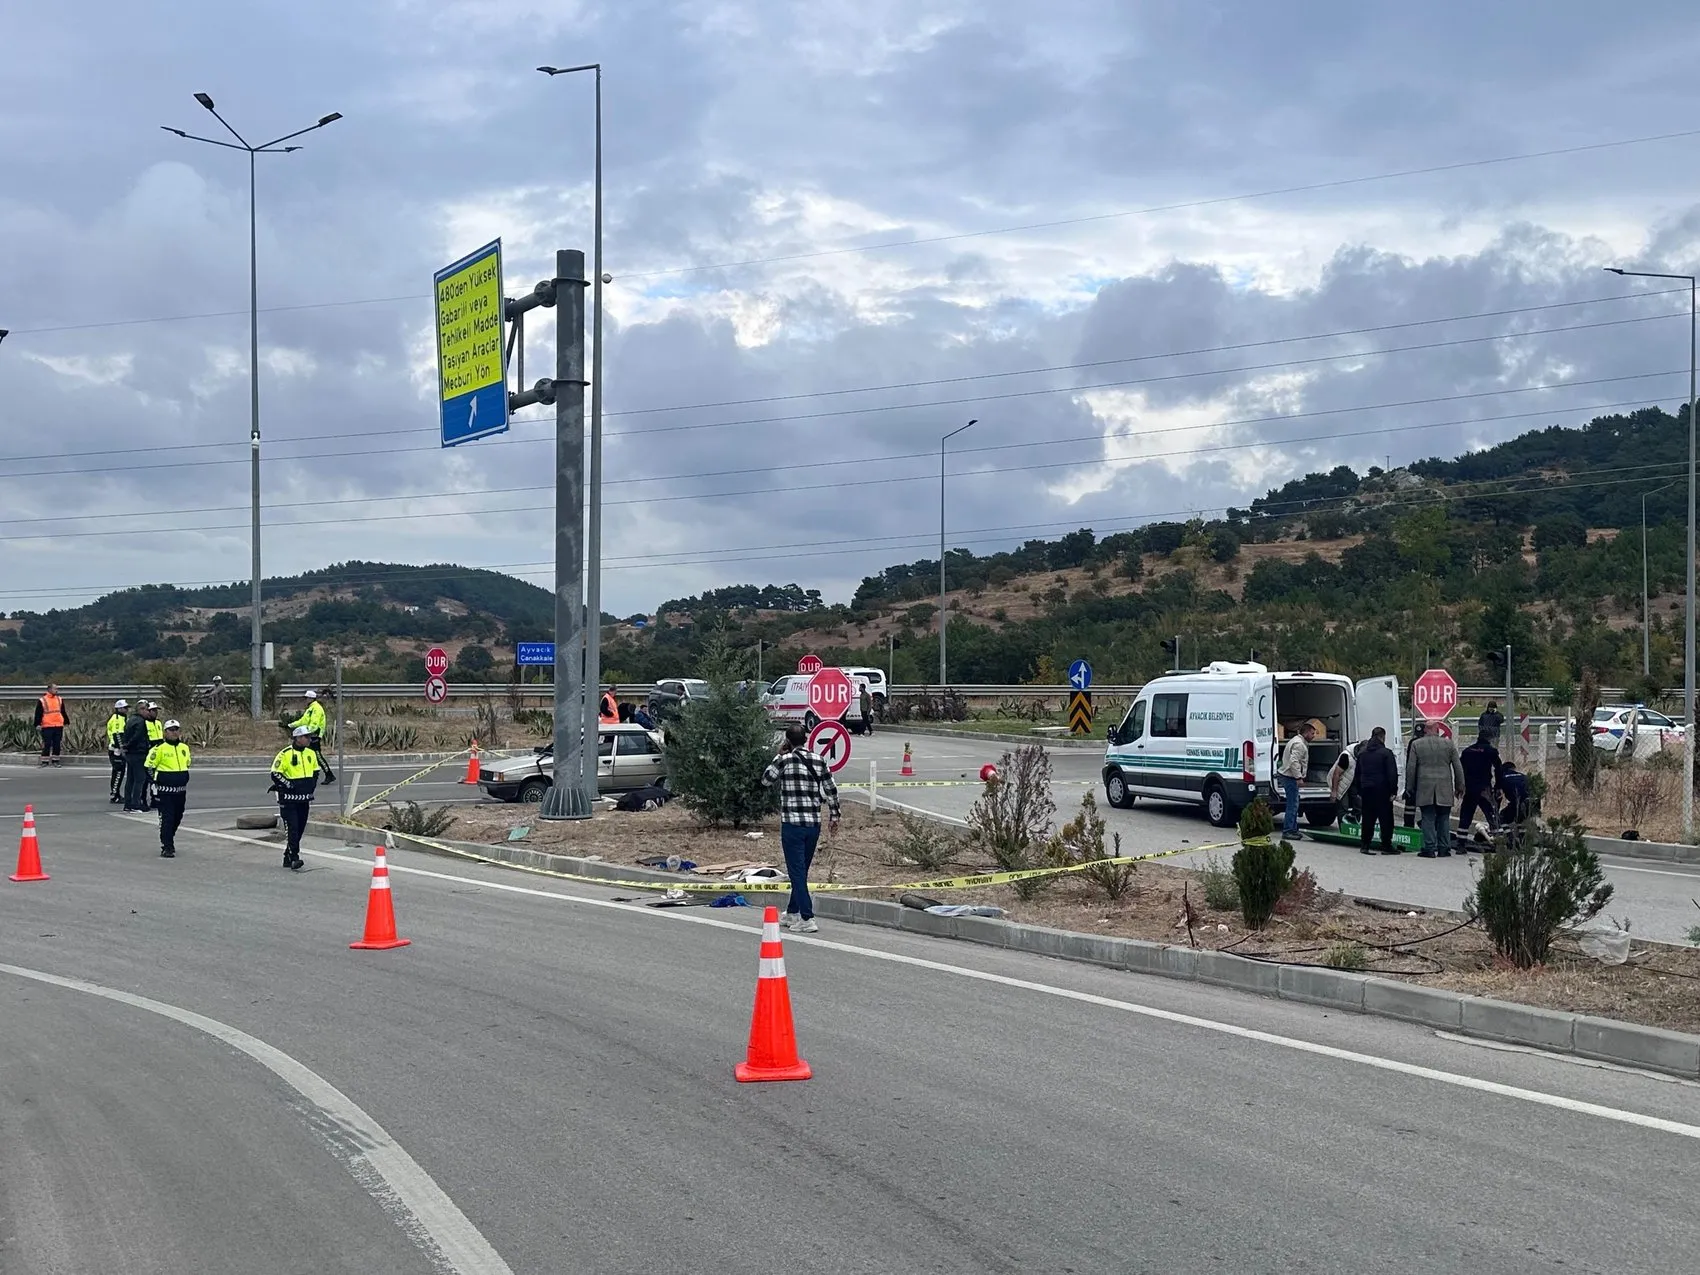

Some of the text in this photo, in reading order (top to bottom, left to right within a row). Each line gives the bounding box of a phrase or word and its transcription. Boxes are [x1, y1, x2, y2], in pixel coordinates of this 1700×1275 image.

[469, 263, 496, 289] Yüksek
[470, 295, 488, 313] veya
[442, 313, 498, 348] Tehlikeli Madde
[472, 336, 499, 359] Araçlar
[444, 364, 490, 392] Mecburi Yön
[427, 656, 446, 667] DUR
[800, 662, 821, 672] DUR
[812, 684, 848, 703] DUR
[1418, 685, 1453, 704] DUR
